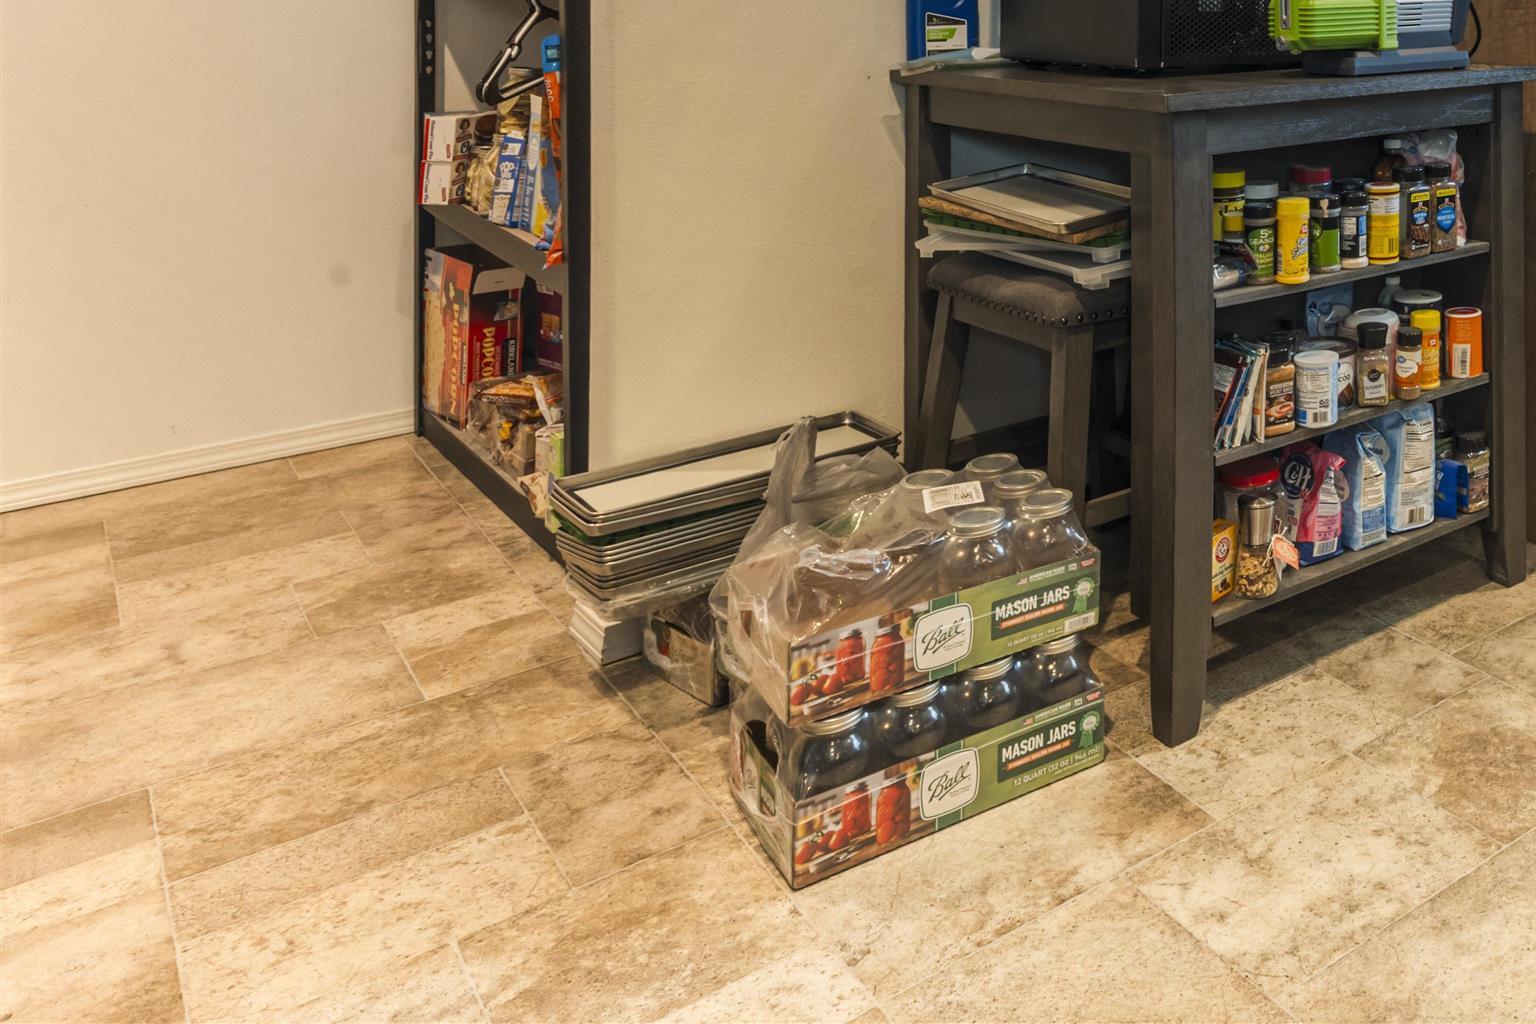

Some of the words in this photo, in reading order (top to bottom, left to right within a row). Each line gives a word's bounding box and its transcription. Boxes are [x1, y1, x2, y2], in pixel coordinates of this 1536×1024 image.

[1248, 237, 1274, 245] SEASO
[481, 326, 496, 381] POPCO
[995, 594, 1038, 621] MASON
[1040, 585, 1071, 607] JARS
[921, 617, 966, 656] Ball
[1001, 733, 1044, 763] MASON
[1047, 720, 1077, 745] JARS
[927, 760, 972, 804] Ball
[1023, 767, 1048, 783] QUART
